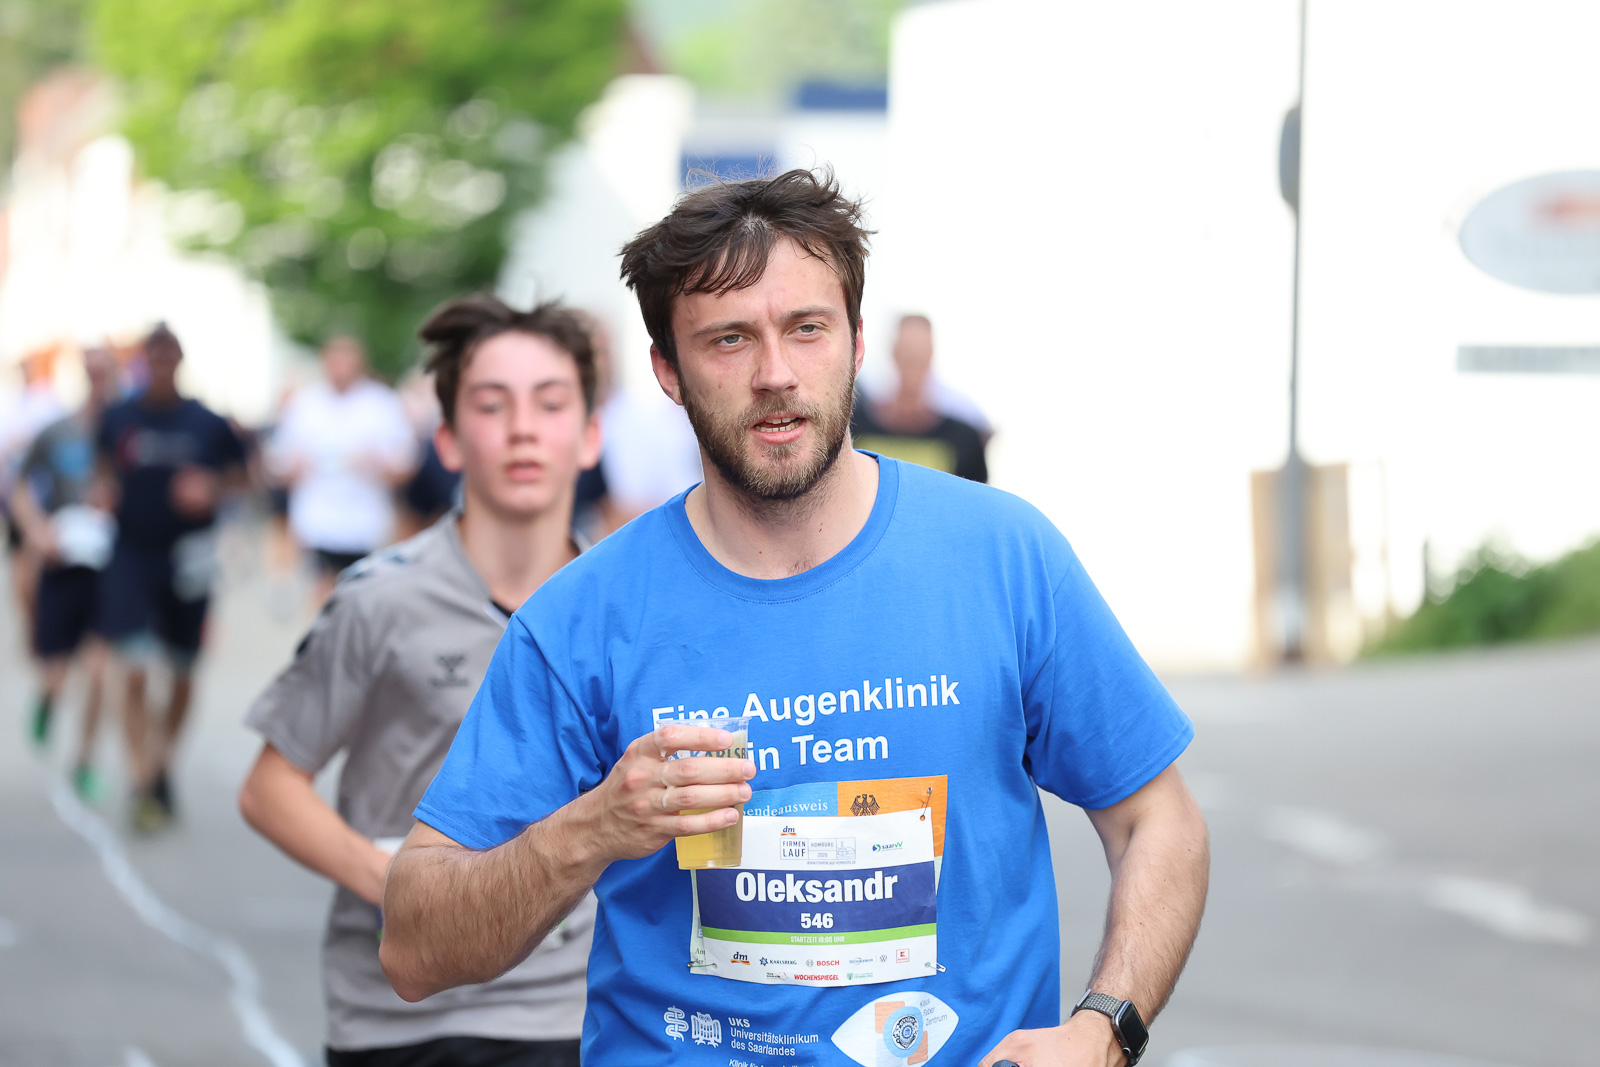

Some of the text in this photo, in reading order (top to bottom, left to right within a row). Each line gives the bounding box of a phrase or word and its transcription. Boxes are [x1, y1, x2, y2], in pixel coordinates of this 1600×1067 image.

[743, 674, 961, 726] Augenklinik
[749, 733, 889, 771] in Team
[743, 799, 828, 817] endeausweis
[782, 840, 806, 848] FIRMEN
[782, 848, 806, 858] LAUF
[735, 870, 898, 902] Oleksandr
[800, 912, 834, 929] 546
[790, 935, 818, 943] STARTZEIT
[833, 935, 846, 943] UHR
[728, 1017, 751, 1028] UKS
[730, 1027, 819, 1045] Universitätsklinikum
[731, 1039, 796, 1056] des Saarlandes
